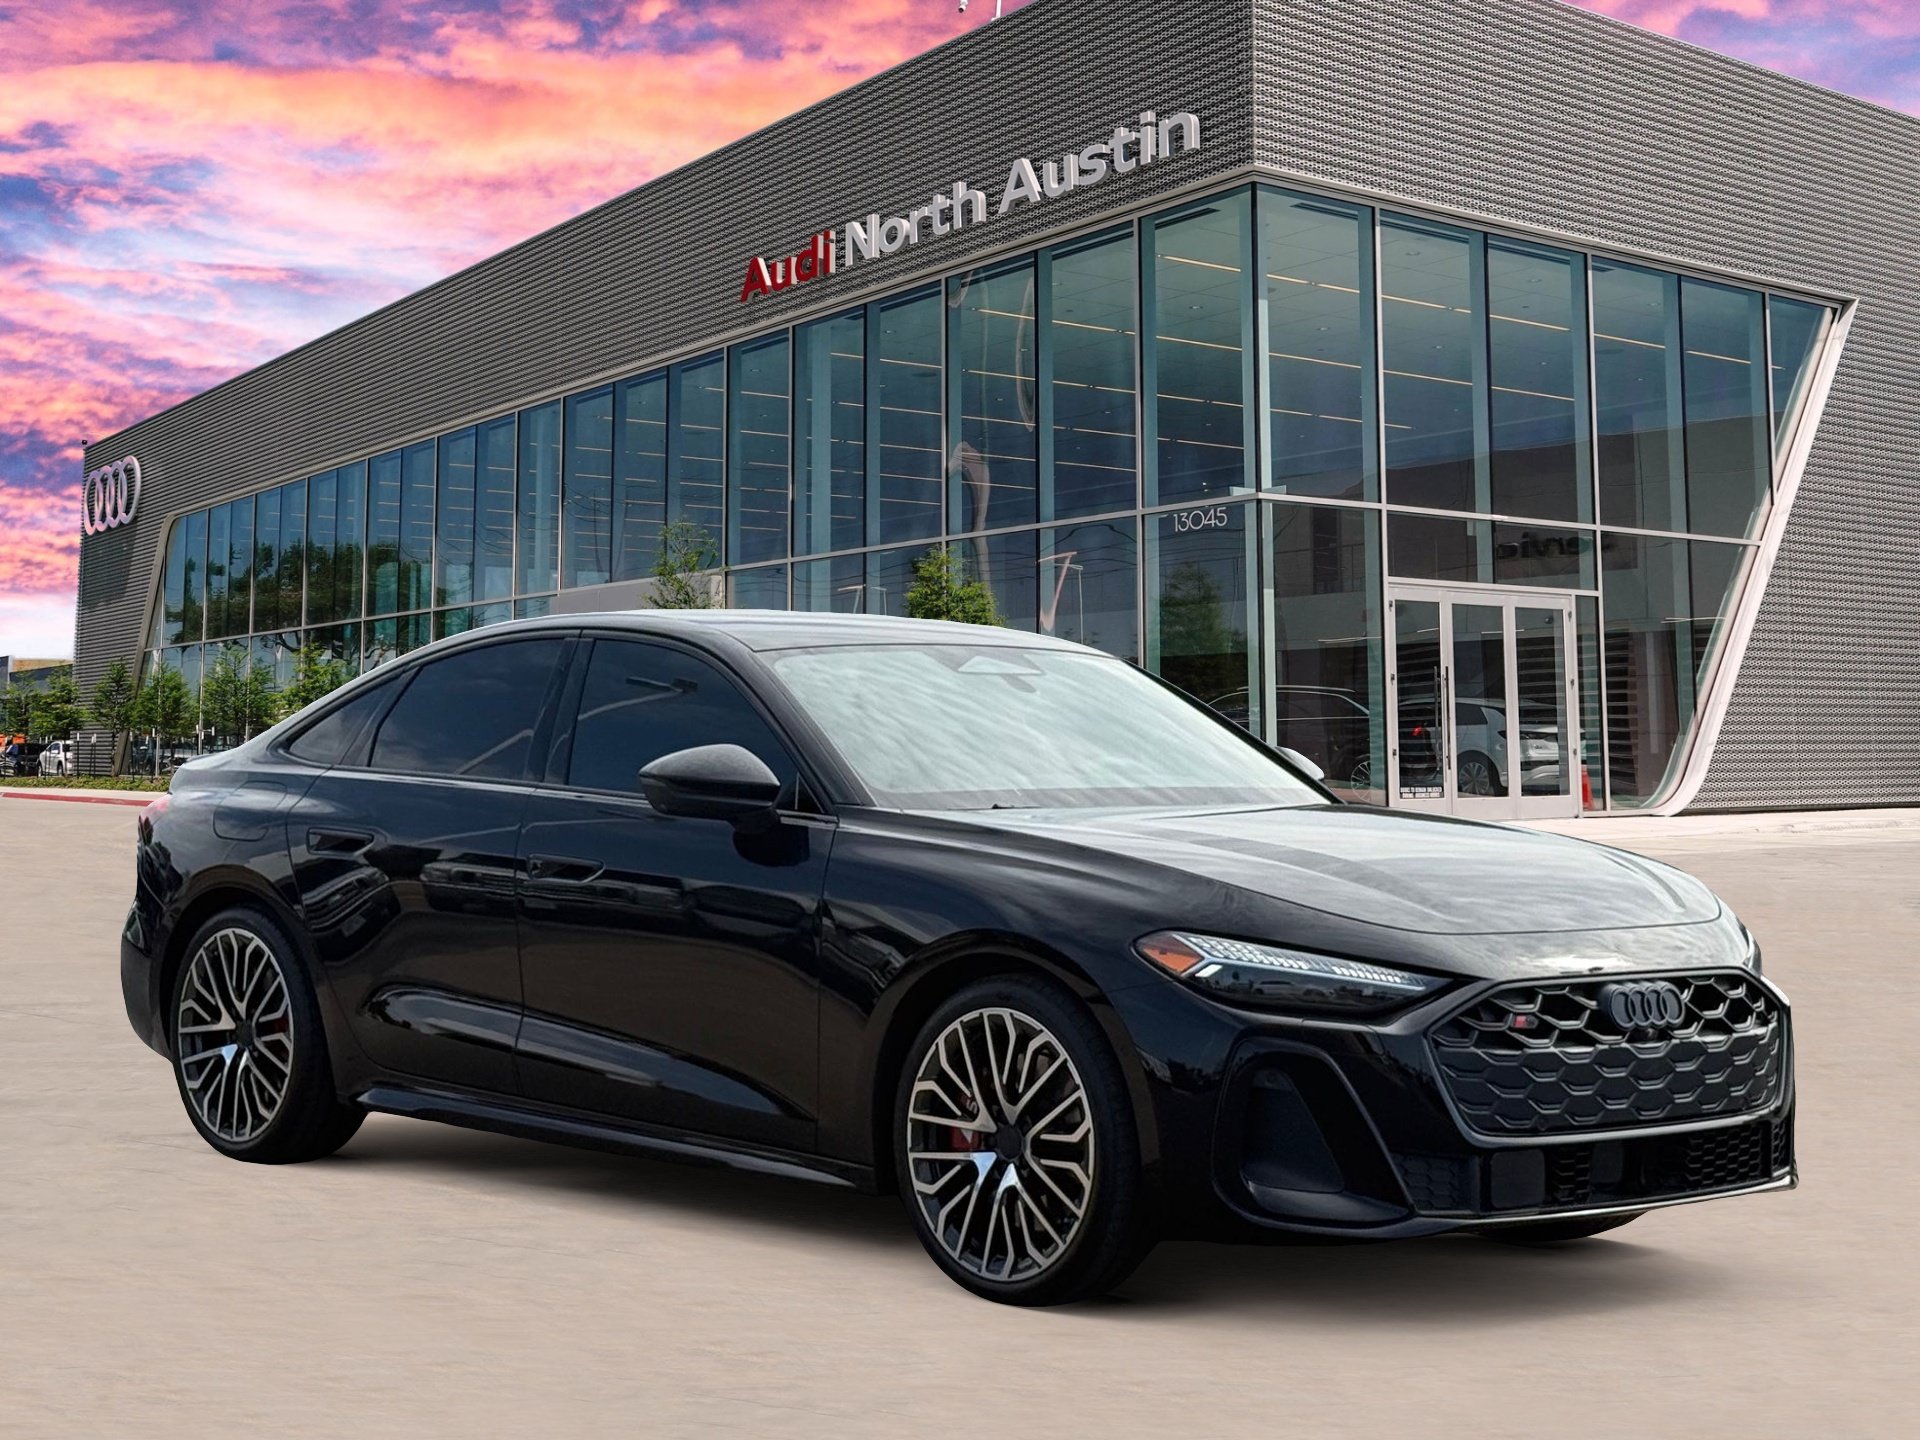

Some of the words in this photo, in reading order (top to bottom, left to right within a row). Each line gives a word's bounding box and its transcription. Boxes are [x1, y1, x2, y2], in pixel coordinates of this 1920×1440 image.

[740, 230, 836, 303] Audi
[845, 181, 987, 267] North
[998, 110, 1201, 214] Austin
[1173, 507, 1228, 532] 13045
